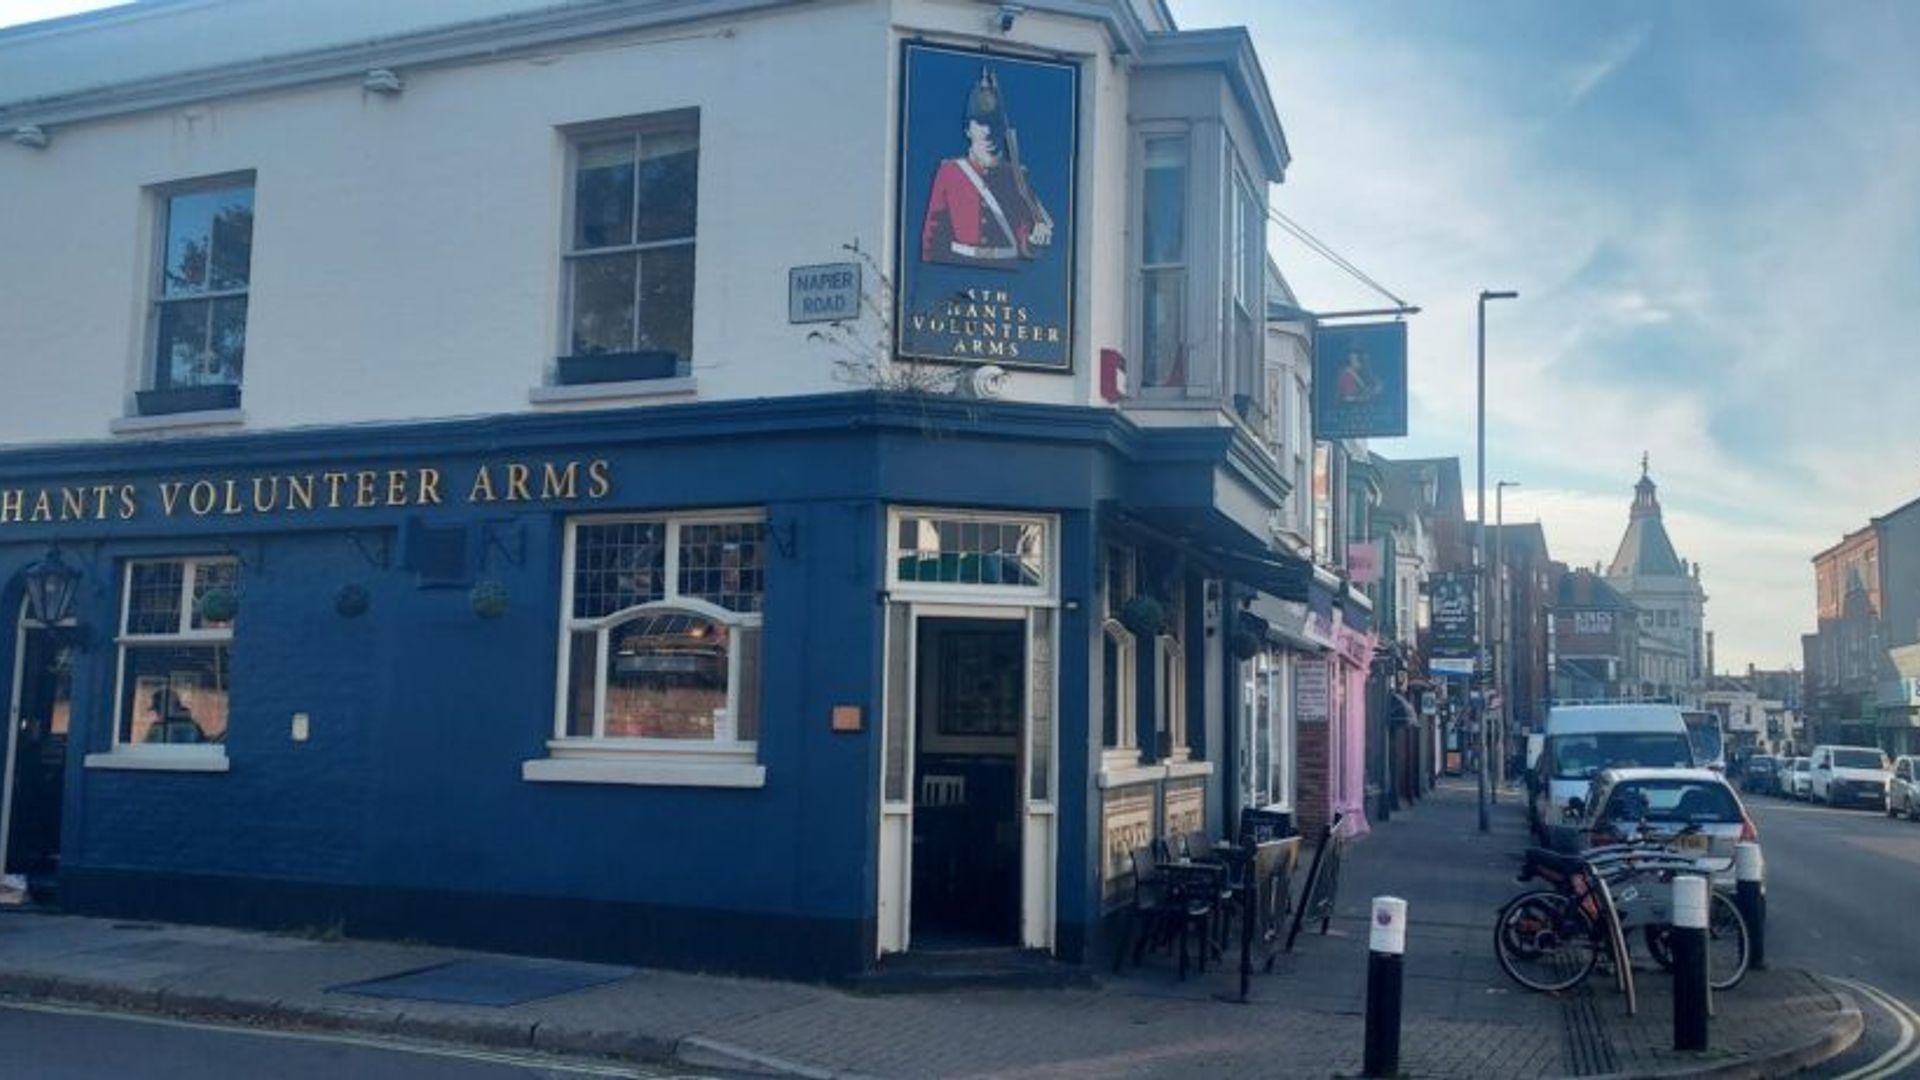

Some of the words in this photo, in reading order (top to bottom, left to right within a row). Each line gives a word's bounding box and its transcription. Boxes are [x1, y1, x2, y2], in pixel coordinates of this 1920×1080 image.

[797, 271, 853, 291] NAPIER
[803, 295, 846, 313] ROAD
[947, 301, 1027, 322] HANTS
[912, 314, 1060, 342] VOLUNTEER
[954, 338, 1019, 357] ARMS
[1, 484, 136, 522] HANTS
[159, 468, 442, 515] VOLUNTEER
[468, 458, 611, 502] ARMS
